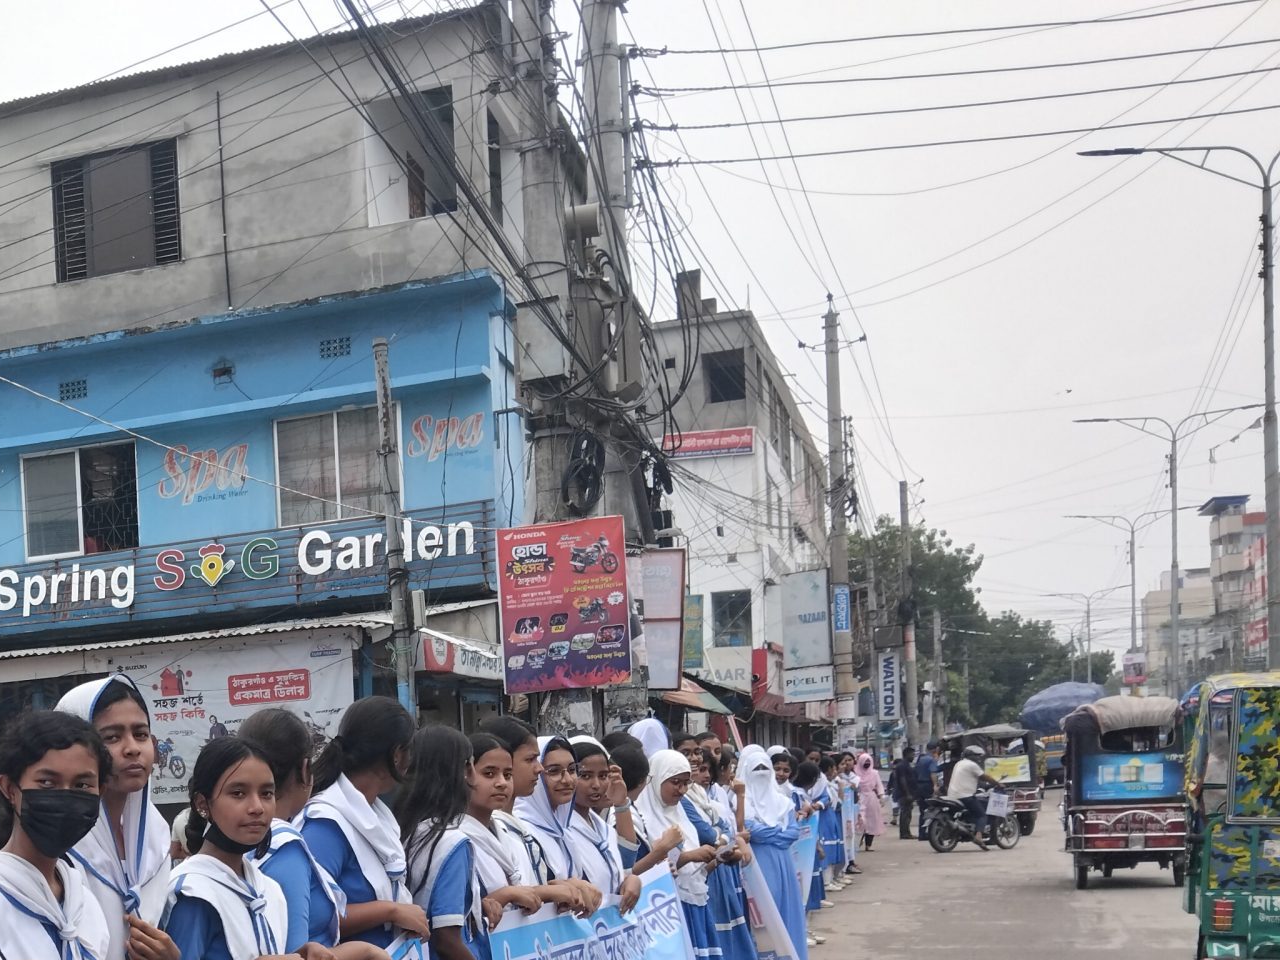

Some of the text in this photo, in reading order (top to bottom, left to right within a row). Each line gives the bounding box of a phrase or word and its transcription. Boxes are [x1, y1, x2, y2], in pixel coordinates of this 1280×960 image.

[158, 443, 249, 504] Spa
[513, 531, 547, 539] HONDA
[125, 664, 148, 672] SUZUKI
[232, 674, 266, 688] ঠাকুরগাঁও
[786, 675, 831, 688] PIXEL IT
[882, 656, 895, 717] WALTON
[274, 684, 305, 698] ডিলার
[153, 697, 179, 710] সহজ
[154, 711, 178, 722] সহজ
